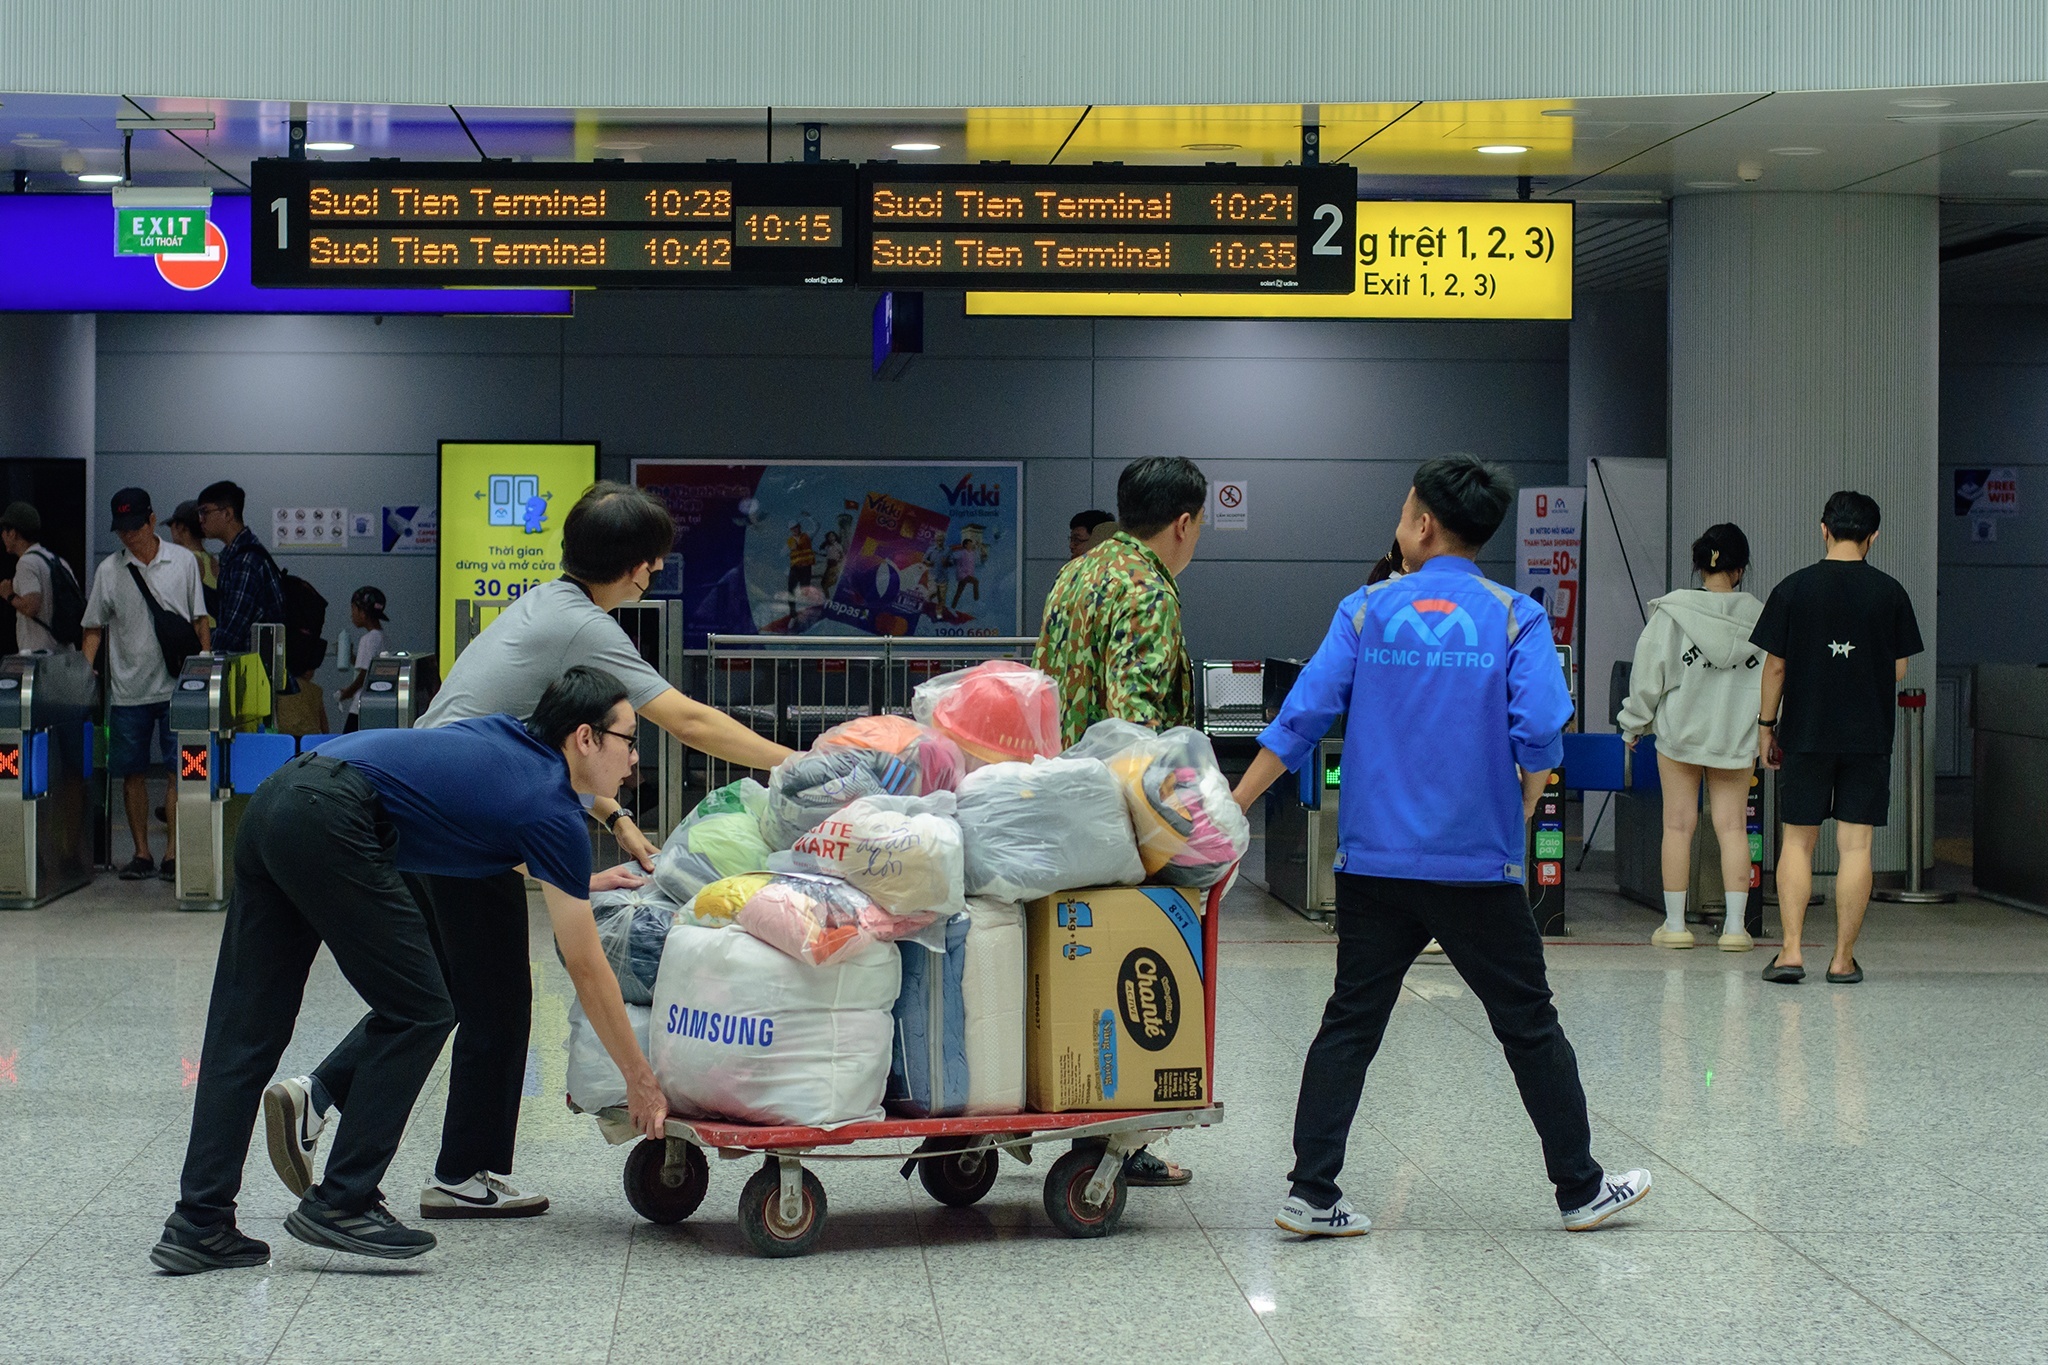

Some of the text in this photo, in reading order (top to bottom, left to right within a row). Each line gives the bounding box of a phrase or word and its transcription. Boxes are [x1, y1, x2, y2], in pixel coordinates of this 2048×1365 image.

[310, 188, 732, 217] Suoi Tien Terminal 10:28
[873, 191, 1293, 220] Suoi Tien Terminal 10:21
[132, 217, 192, 235] EXIT
[270, 197, 288, 249] 1
[744, 214, 832, 241] 10:15
[1311, 203, 1344, 256] 2
[155, 235, 183, 247] THOÁT
[310, 237, 732, 266] Suoi Tien Terminal 10:42
[873, 239, 1296, 269] Suoi Tien Terminal 10:35
[1389, 226, 1447, 267] trệt
[1457, 226, 1477, 262] 1,
[1486, 226, 1514, 262] 2,
[1525, 226, 1555, 263] 3)
[1363, 272, 1497, 299] Exit 1, 2, 3)
[940, 473, 1001, 507] Vikki
[456, 558, 489, 573] dừng
[490, 559, 506, 571] và
[508, 559, 529, 571] mở
[531, 558, 556, 571] cửa
[488, 545, 544, 559] Thời gian
[474, 578, 501, 597] 30
[823, 600, 861, 619] napas
[1364, 647, 1496, 669] HCMC METRO
[1539, 837, 1560, 847] Zalo
[1539, 846, 1558, 856] pay
[1542, 875, 1556, 884] Pay
[1068, 917, 1077, 931] kg
[1067, 946, 1077, 961] kg
[1127, 984, 1138, 1017] ACTIVE
[1133, 957, 1166, 1039] Chanté
[667, 1003, 774, 1047] SAMSUNG
